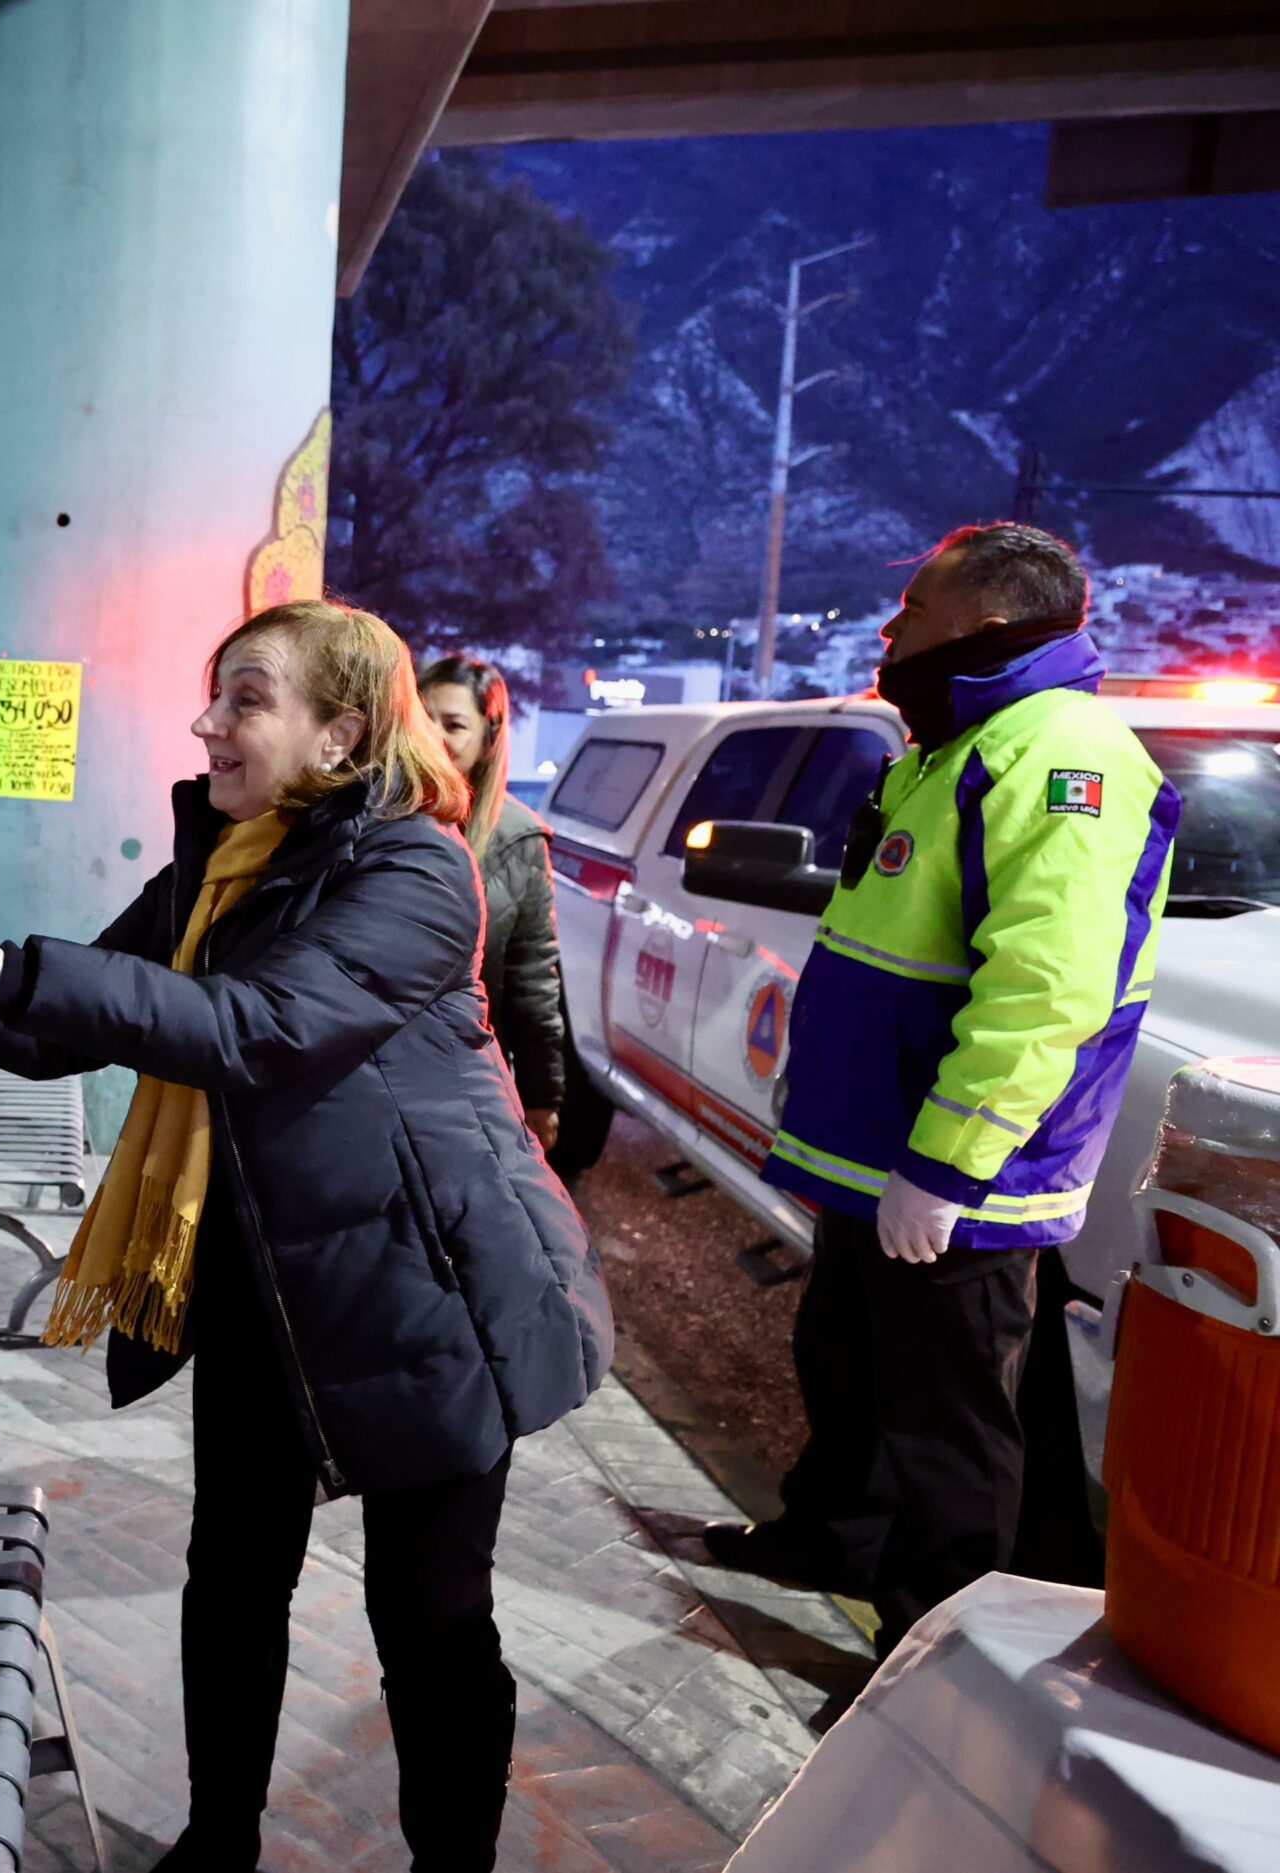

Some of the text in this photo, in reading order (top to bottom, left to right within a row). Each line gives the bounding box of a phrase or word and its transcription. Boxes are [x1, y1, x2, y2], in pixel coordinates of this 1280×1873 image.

[1052, 771, 1101, 784] MEXICO
[1049, 804, 1079, 812] NUEVO
[634, 949, 677, 1002] 911
